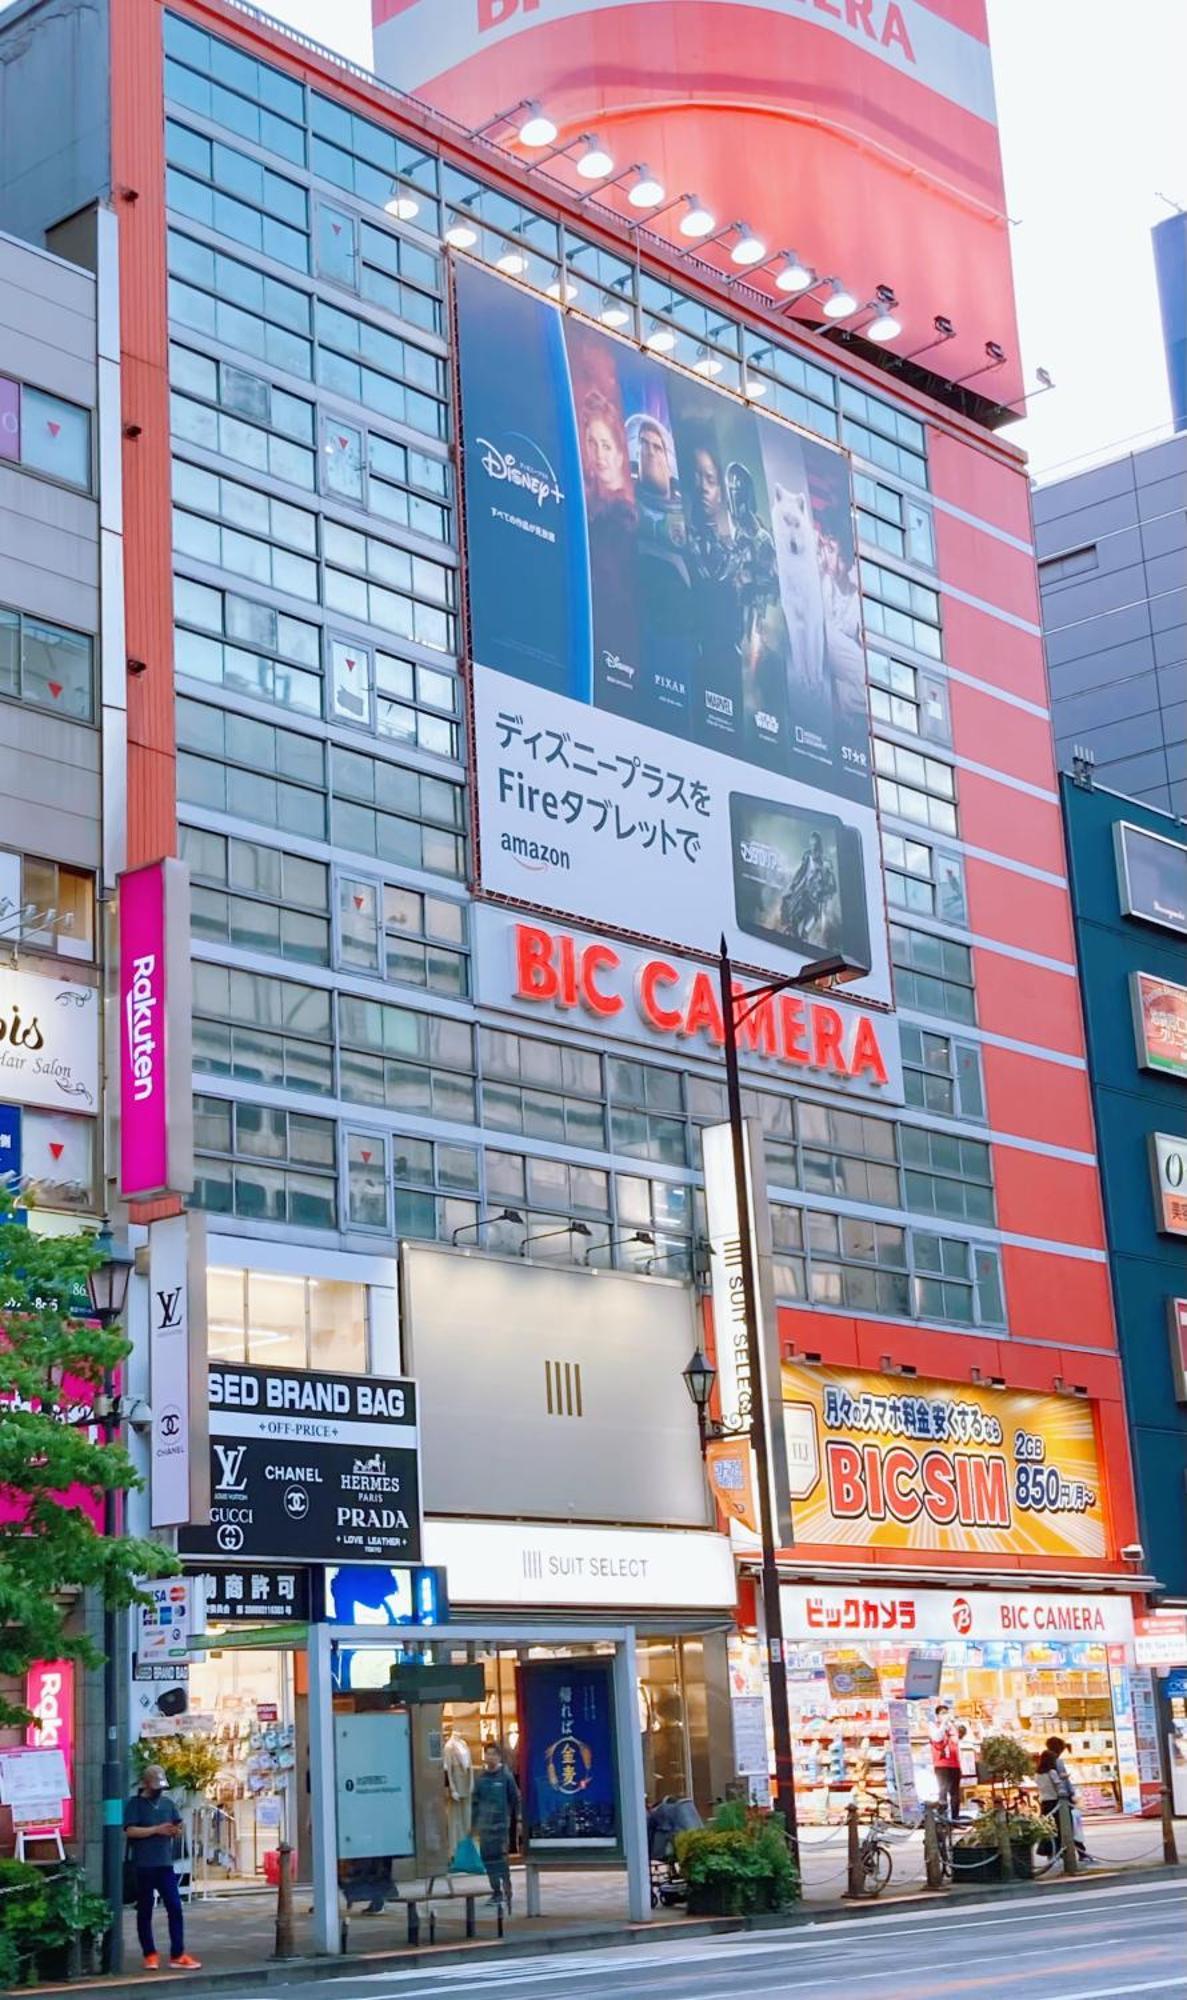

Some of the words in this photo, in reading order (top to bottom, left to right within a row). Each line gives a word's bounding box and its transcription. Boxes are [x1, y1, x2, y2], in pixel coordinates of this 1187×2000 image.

[654, 674, 685, 695] PIXAR
[496, 712, 711, 817] ディズニープラスを
[498, 767, 701, 864] Fireタブレットで
[501, 832, 570, 870] amazon
[513, 924, 624, 1017] BIC
[637, 960, 889, 1086] CAMERA
[126, 954, 156, 1101] Rakuten
[32, 1056, 72, 1078] Salon
[266, 1378, 350, 1413] BRAND
[357, 1386, 405, 1417] BAG
[826, 1389, 1001, 1440] 月々のスマホ料金安くするなら
[268, 1421, 331, 1438] OFF-PRICE
[156, 1447, 184, 1458] CHANEL
[1016, 1432, 1042, 1456] 2GB
[265, 1465, 323, 1482] CHANEL
[341, 1474, 400, 1492] HERMES
[828, 1444, 919, 1520] BIC
[922, 1454, 1009, 1526] SIM
[358, 1492, 383, 1502] PARIS
[209, 1507, 253, 1524] GUCCI
[337, 1507, 409, 1529] PRADA
[343, 1535, 363, 1545] LOVE
[367, 1537, 401, 1547] LEATHER
[548, 1557, 584, 1577] SUIT
[590, 1559, 650, 1580] SELECT
[806, 1599, 915, 1629] ビックカメラ
[1000, 1605, 1029, 1629] BIC
[1033, 1606, 1105, 1631] CAMERA
